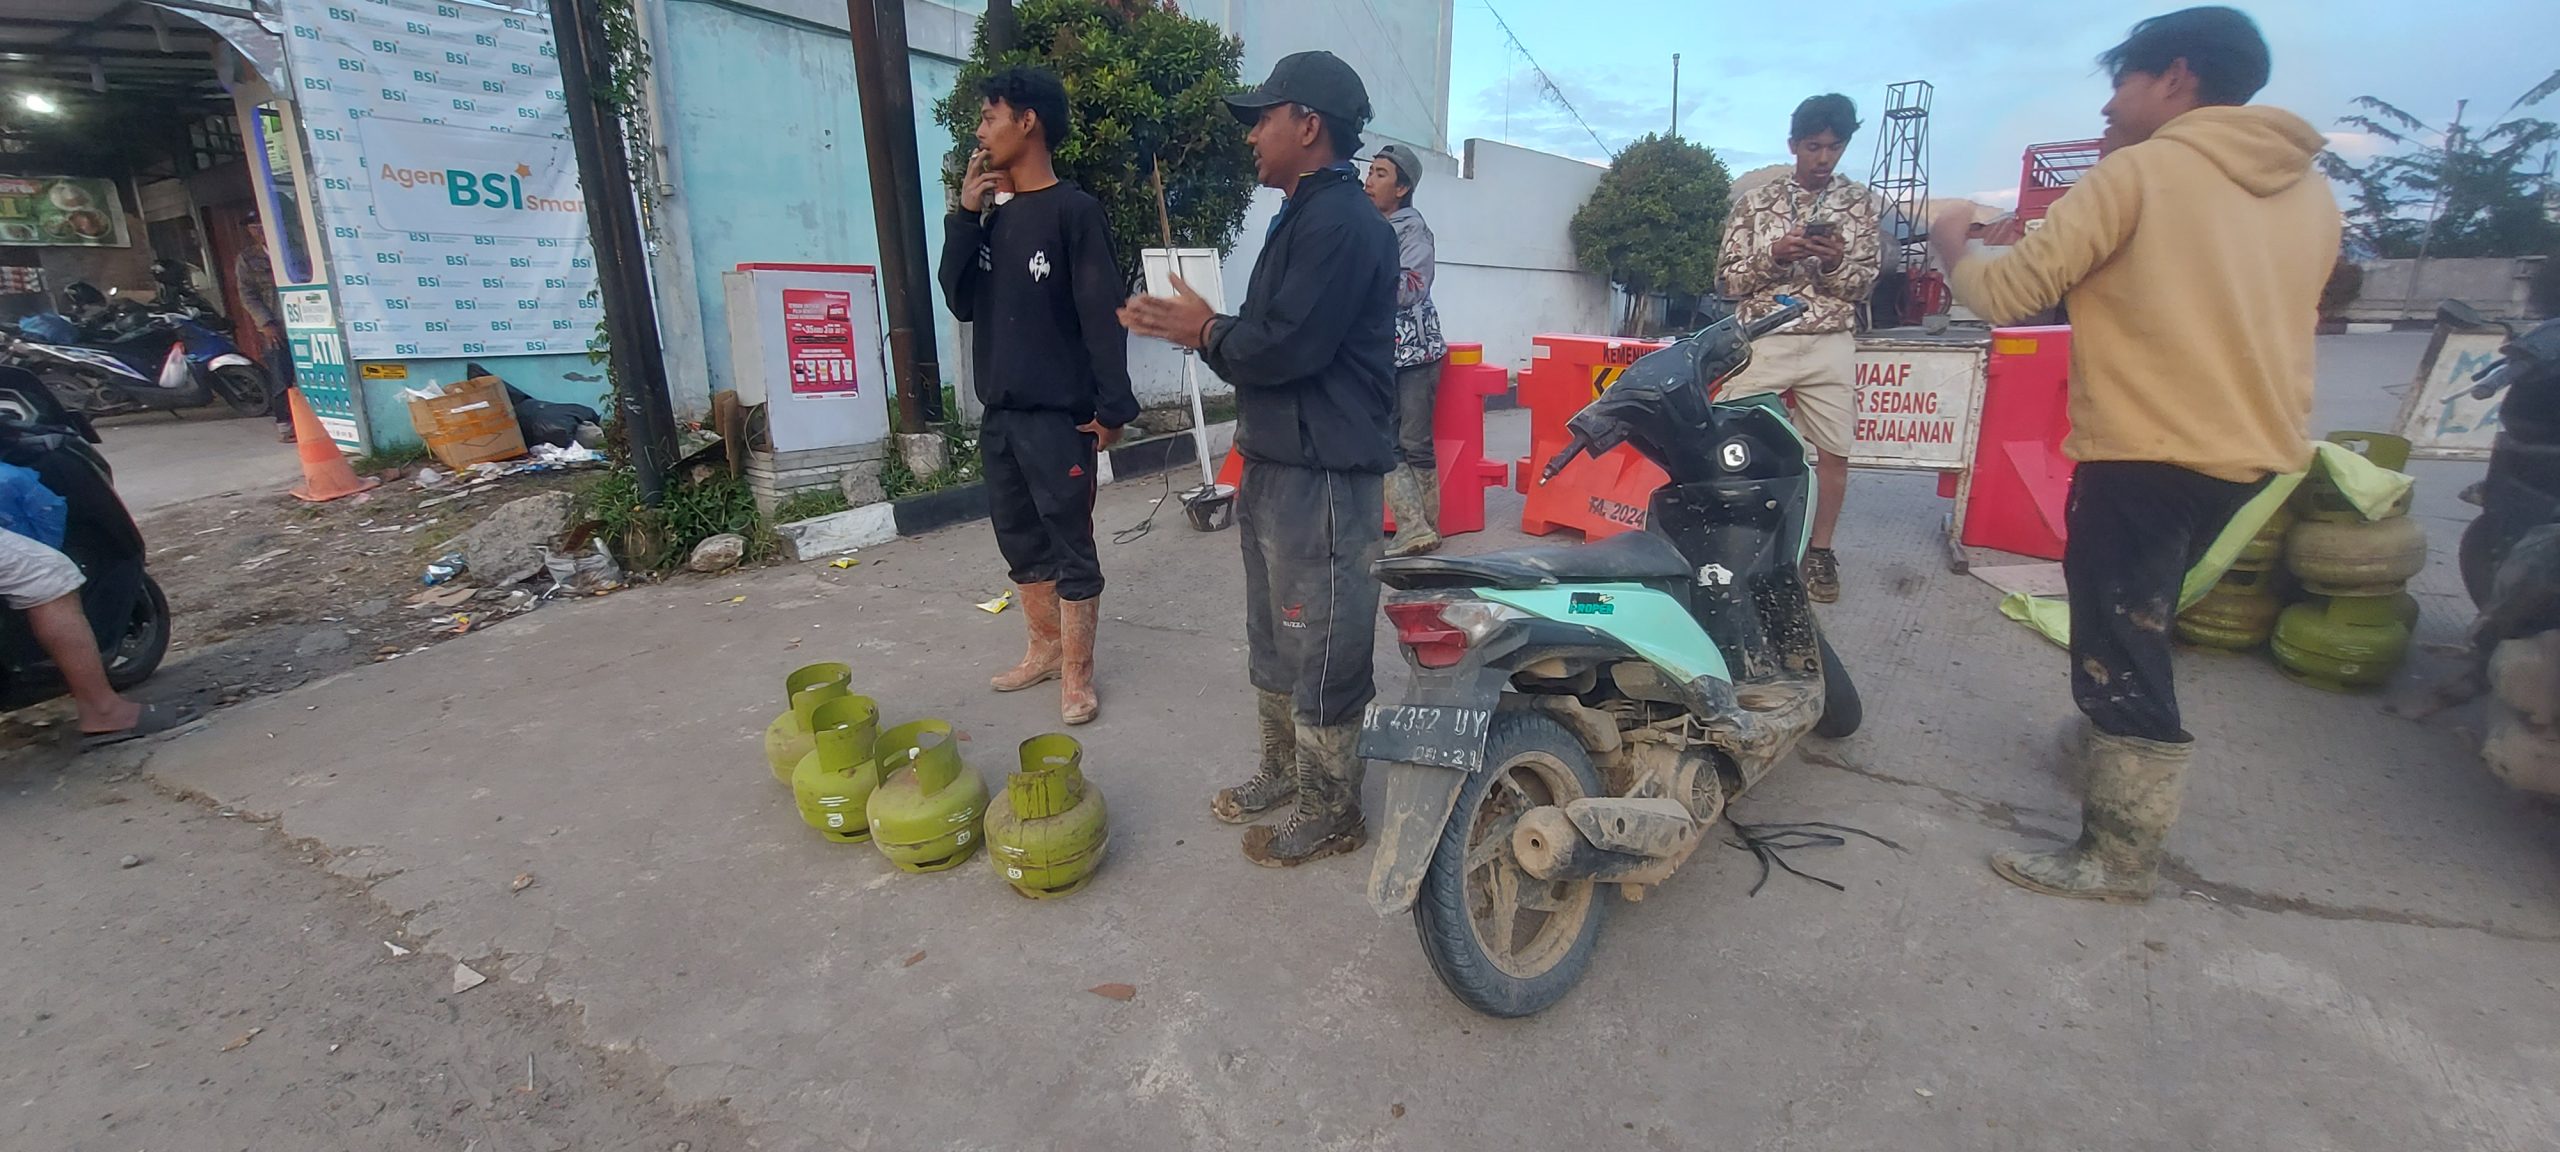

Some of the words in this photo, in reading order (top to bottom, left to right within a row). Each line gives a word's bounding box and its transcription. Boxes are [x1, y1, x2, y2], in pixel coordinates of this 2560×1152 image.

[329, 7, 355, 22] BSI
[438, 5, 460, 18] BSI
[407, 22, 431, 35] BSI
[504, 18, 525, 30] BSI
[294, 25, 319, 40] BSI
[475, 34, 497, 47] BSI
[373, 40, 398, 54] BSI
[540, 45, 557, 59] BS
[446, 52, 468, 65] BSI
[338, 58, 364, 72] BSI
[512, 63, 532, 76] BSI
[413, 70, 437, 83] BSI
[304, 77, 331, 91] BSI
[482, 80, 504, 93] BSI
[382, 89, 406, 102] BSI
[453, 99, 475, 111] BSI
[518, 107, 540, 119] BSI
[314, 129, 341, 141] BSI
[325, 178, 351, 191] BSI
[381, 163, 446, 188] Agen
[446, 169, 523, 210] BSI
[527, 195, 585, 213] Smar
[335, 227, 359, 239] BSI
[409, 232, 431, 243] BSI
[475, 235, 496, 245] BSI
[377, 252, 400, 264] BSI
[446, 255, 468, 266] BSI
[510, 258, 530, 268] BSI
[572, 258, 591, 268] BSI
[345, 275, 369, 286] BSI
[418, 277, 440, 287] BSI
[482, 278, 504, 288] BSI
[546, 279, 566, 288] BSI
[385, 299, 409, 310] BSI
[455, 300, 476, 310] BSI
[518, 300, 539, 309] BSI
[578, 299, 597, 309] BSI
[354, 322, 378, 332] BSI
[425, 322, 448, 332] BSI
[491, 321, 512, 331] BSI
[553, 320, 572, 329] BSI
[310, 334, 345, 365] ATM
[396, 344, 418, 354] BSI
[463, 343, 485, 353] BSI
[526, 342, 546, 351] BSI
[1855, 363, 1911, 386] MAAF
[1870, 391, 1937, 414] SEDANG
[1855, 419, 1955, 444] ERJALANAN
[1610, 503, 1647, 527] 2024
[1454, 708, 1487, 738] UY
